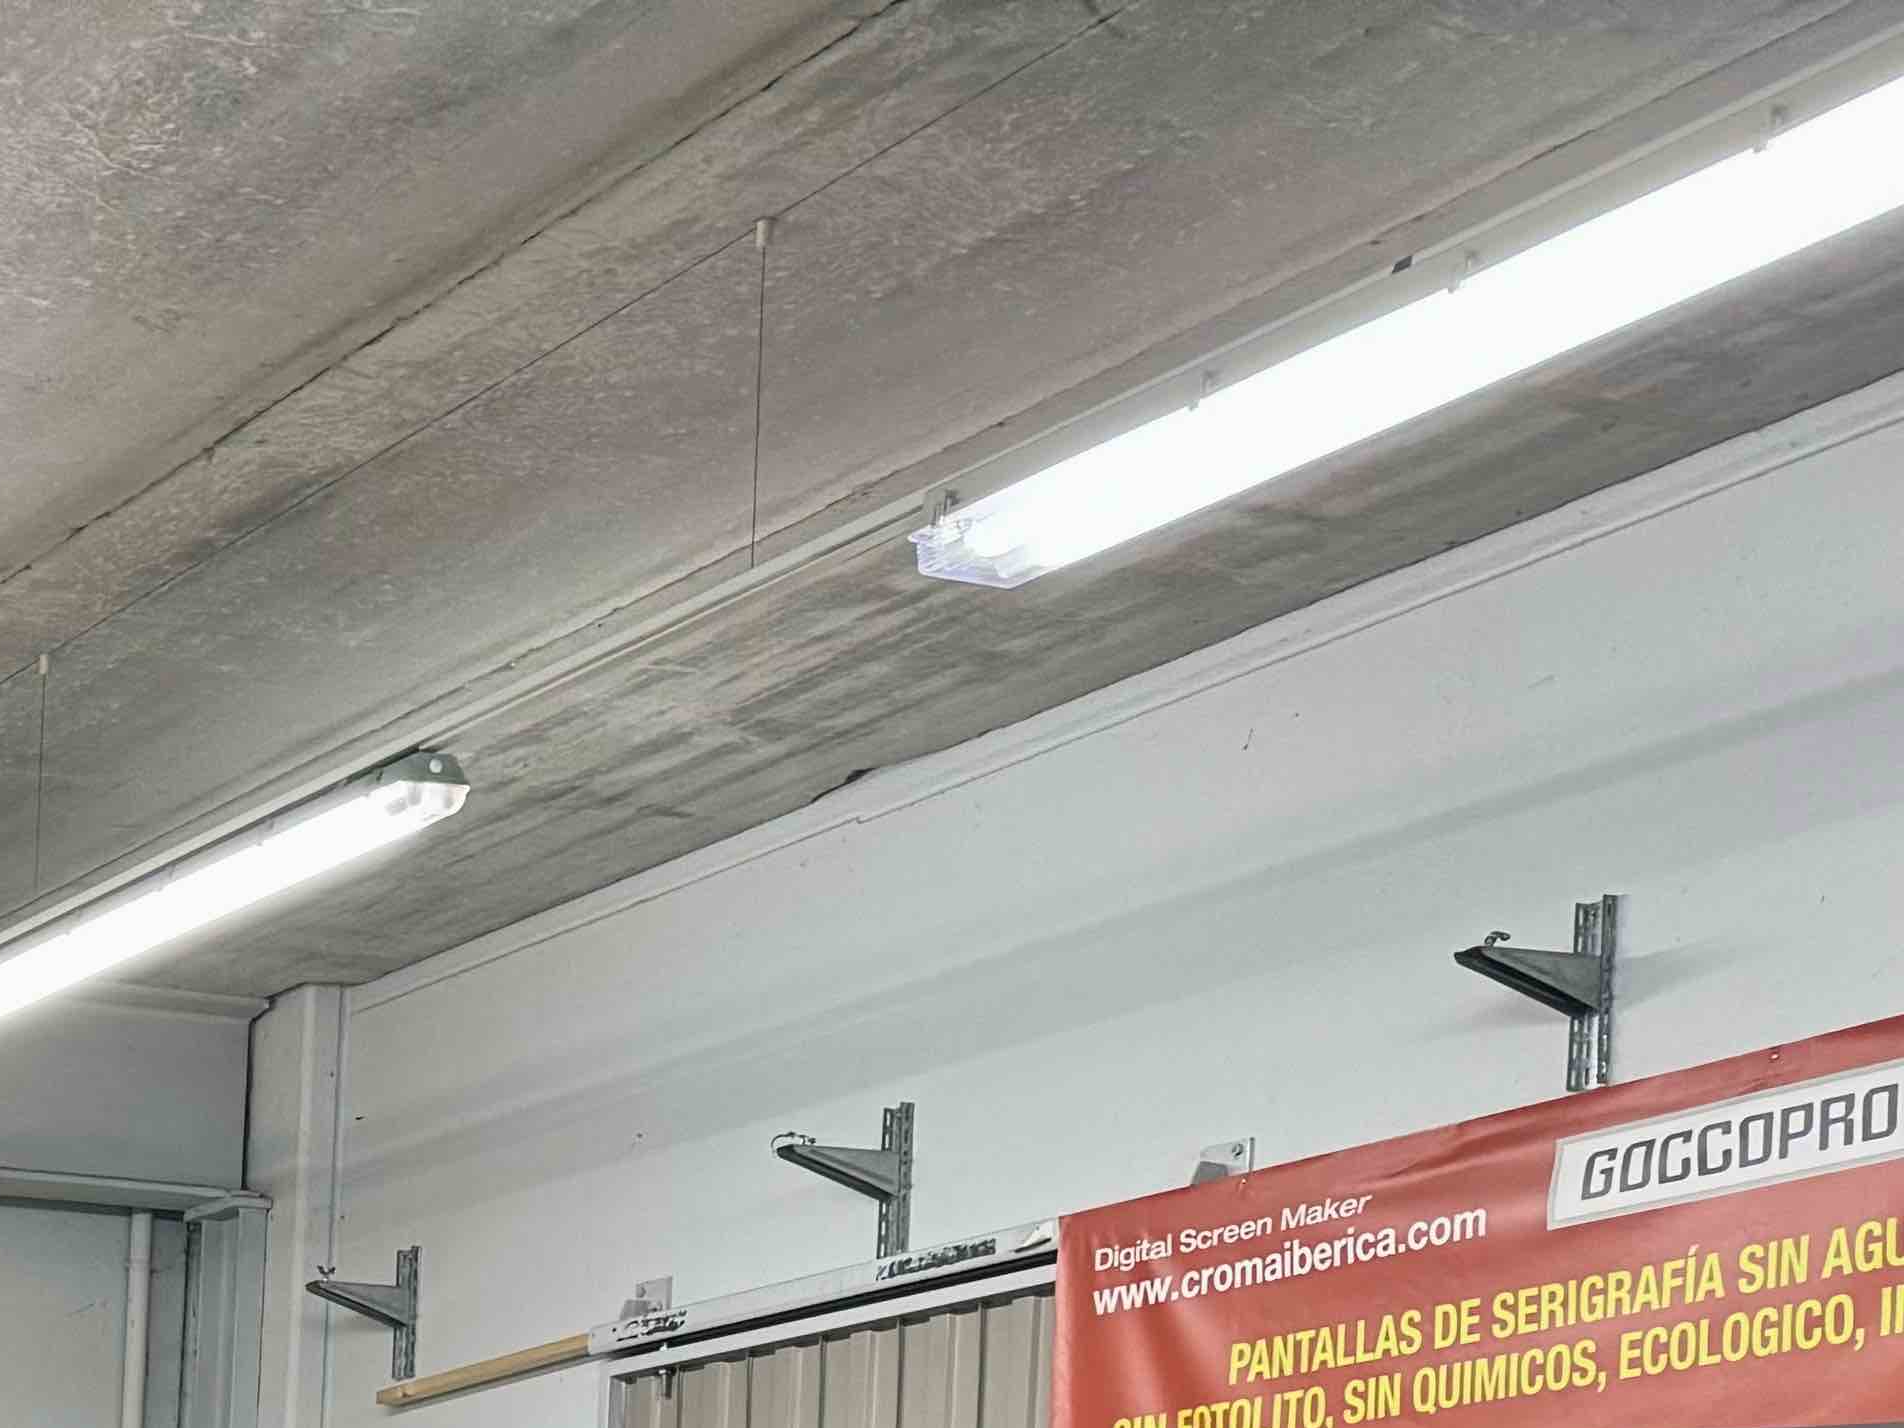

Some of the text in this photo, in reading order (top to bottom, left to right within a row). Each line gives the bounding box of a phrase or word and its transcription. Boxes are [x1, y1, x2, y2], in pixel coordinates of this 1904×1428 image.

[1581, 1083, 1899, 1200] GOCCOPRO
[1093, 1208, 1487, 1315] www.cromaiberica.com
[1094, 1194, 1373, 1273] Digital Screen Maker
[1228, 1310, 1423, 1385] PANTALLAS
[1433, 1297, 1481, 1349] DE
[1491, 1245, 1725, 1339] SERIGRAFÍA
[1738, 1234, 1810, 1295] SIN
[1343, 1373, 1400, 1424] SIN
[1412, 1339, 1607, 1416] QUIMICOS,
[1618, 1293, 1866, 1380] ECOLOGICO,
